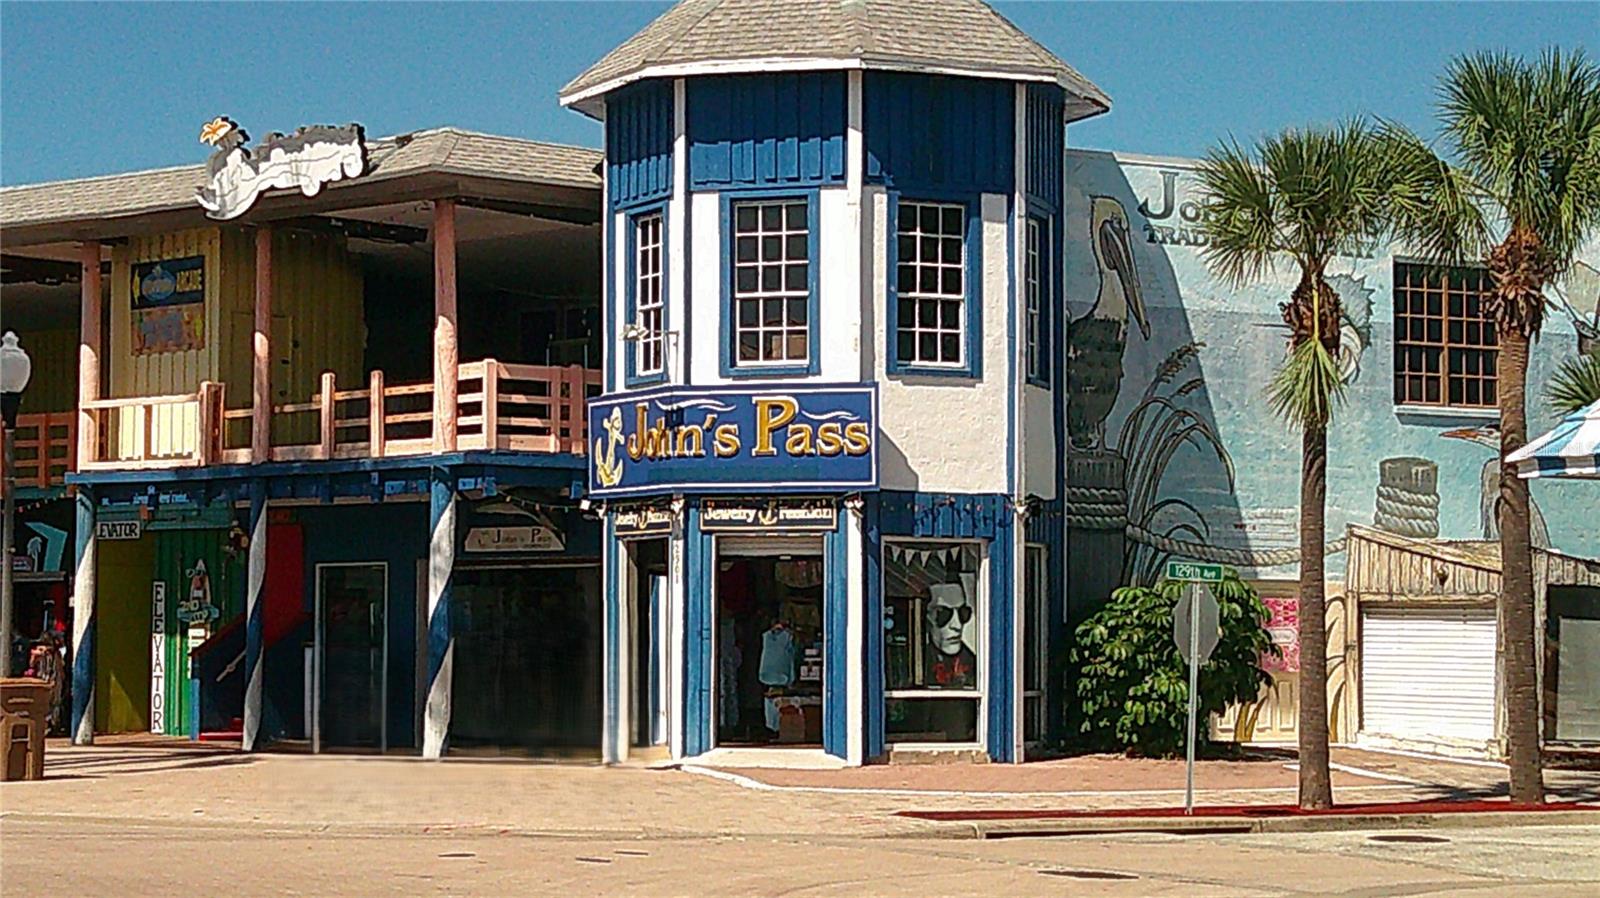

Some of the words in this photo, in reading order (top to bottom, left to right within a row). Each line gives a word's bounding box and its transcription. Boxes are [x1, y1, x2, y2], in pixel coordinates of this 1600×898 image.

[626, 401, 741, 461] John's
[751, 396, 871, 459] Pass
[98, 522, 138, 538] EVATOR
[152, 584, 164, 731] ELEVATOR
